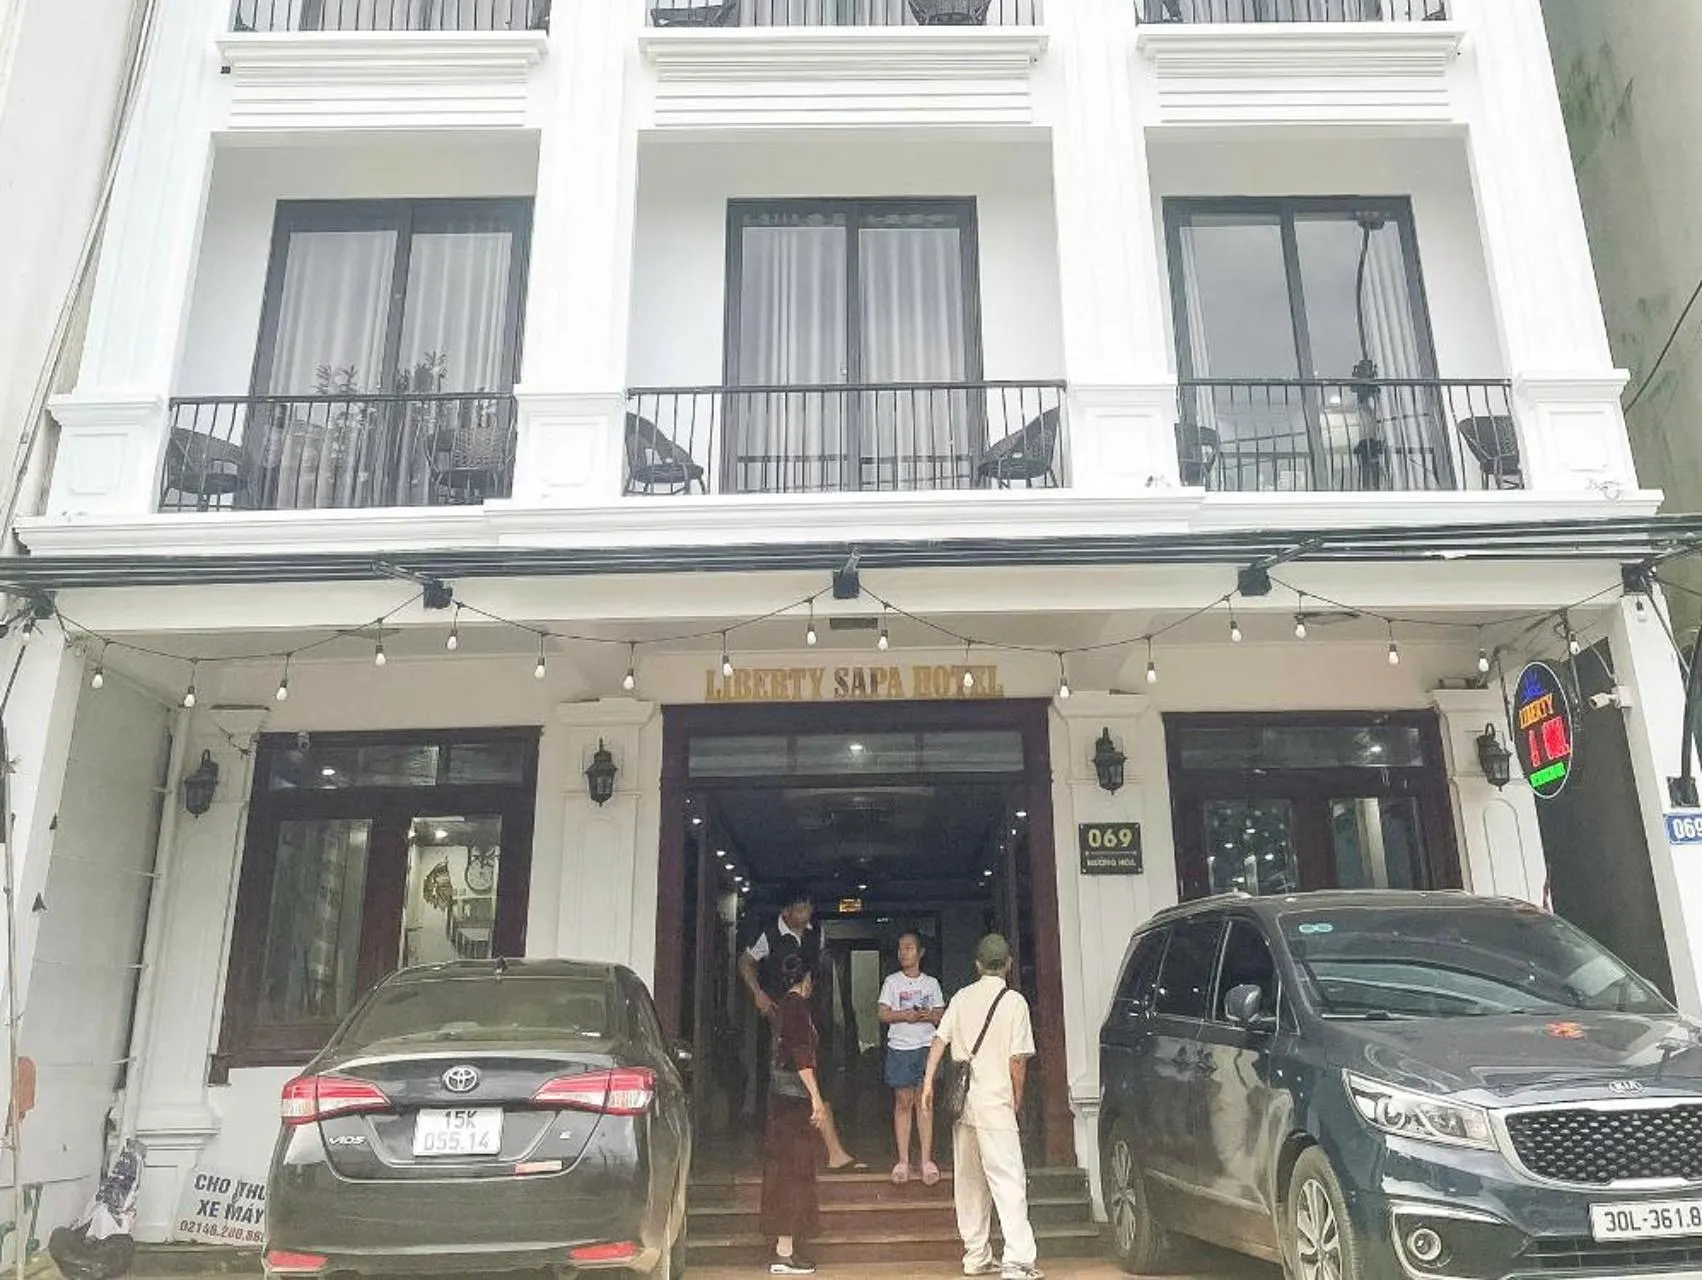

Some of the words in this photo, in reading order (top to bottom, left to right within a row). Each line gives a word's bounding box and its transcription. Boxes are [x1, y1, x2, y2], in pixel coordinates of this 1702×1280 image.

[704, 667, 825, 702] LIBERTY
[834, 666, 904, 700] SAPA
[912, 665, 1005, 699] HOTEL
[1519, 693, 1554, 730] LIBERTY
[1088, 828, 1132, 847] 069
[1673, 818, 1702, 838] 069
[445, 1110, 478, 1129] 15K
[329, 1135, 365, 1144] VIOS
[194, 1174, 231, 1194] CHO
[196, 1200, 220, 1217] XE
[224, 1203, 264, 1224] MÁY
